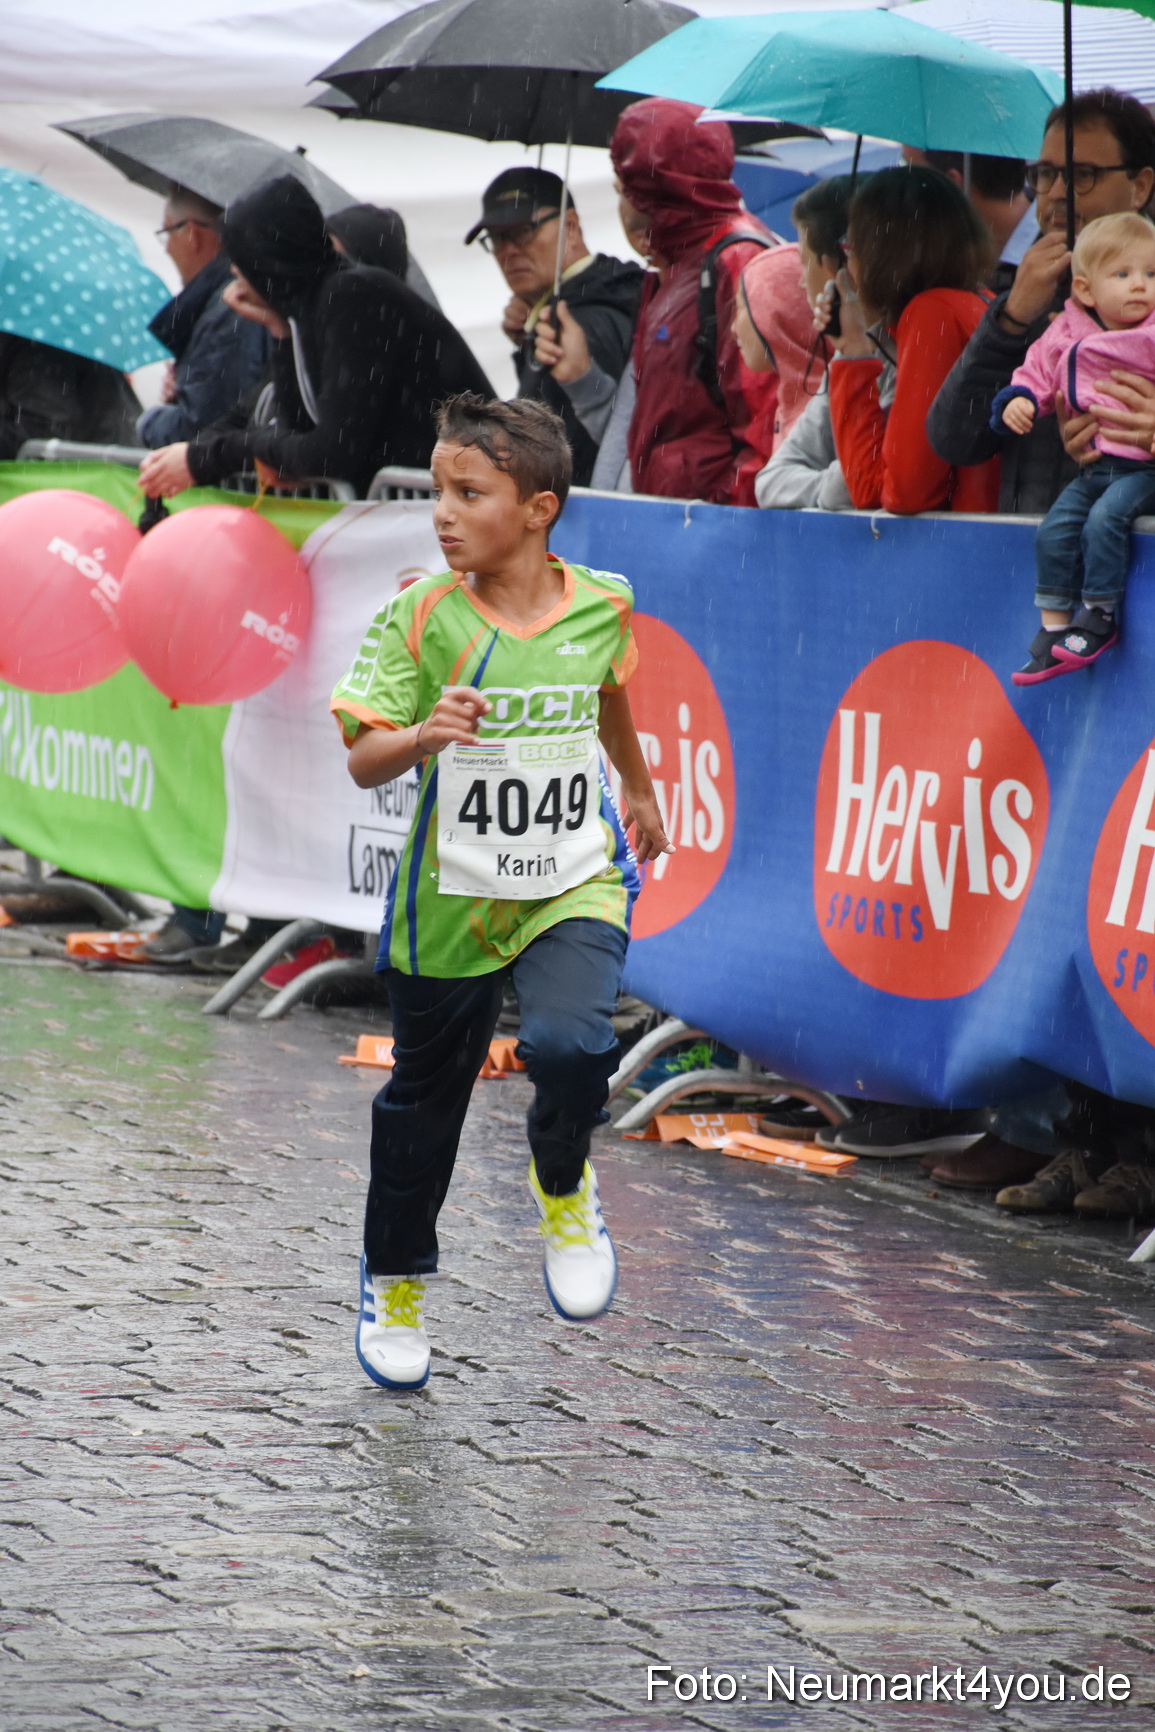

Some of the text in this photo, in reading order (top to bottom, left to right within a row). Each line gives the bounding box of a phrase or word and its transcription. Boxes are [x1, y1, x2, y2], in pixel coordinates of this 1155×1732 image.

[441, 684, 600, 730] OCK
[519, 738, 588, 762] BOCK
[458, 773, 588, 837] 4049
[825, 708, 1033, 931] Hervis
[349, 824, 402, 898] Lam
[497, 853, 558, 877] Karim
[825, 891, 924, 943] SPORTS
